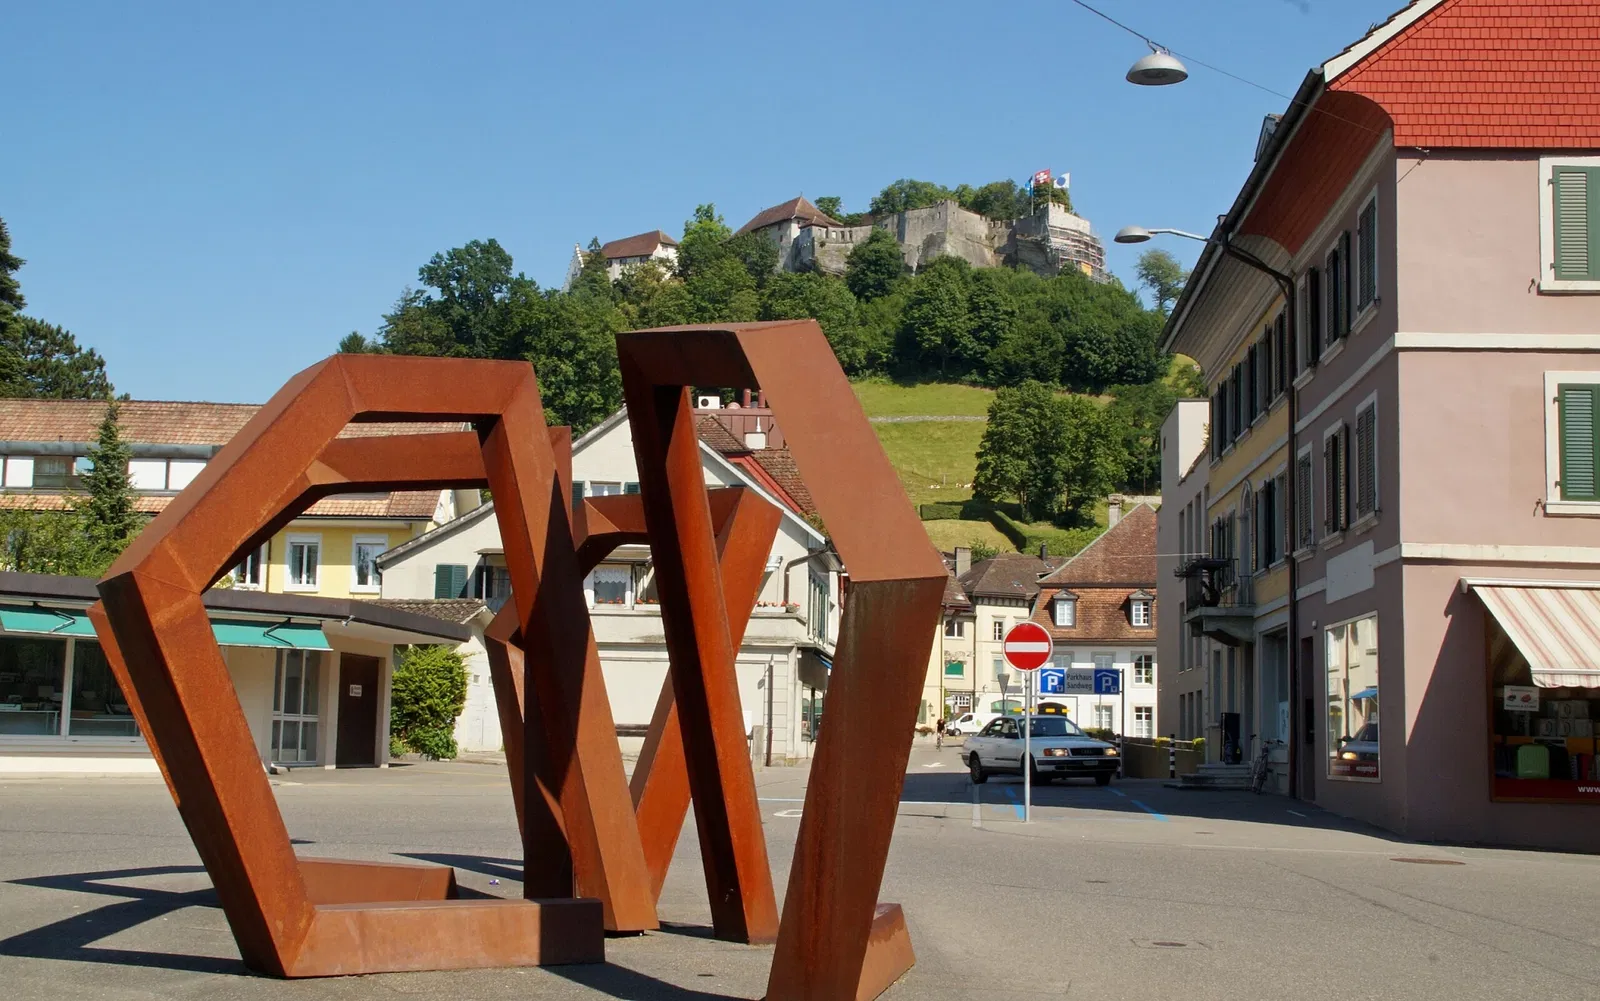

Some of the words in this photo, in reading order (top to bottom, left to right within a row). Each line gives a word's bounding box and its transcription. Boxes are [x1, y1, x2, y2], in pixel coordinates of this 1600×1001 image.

[1047, 676, 1058, 691] P
[1067, 682, 1092, 691] Sandweg
[1102, 677, 1112, 692] P
